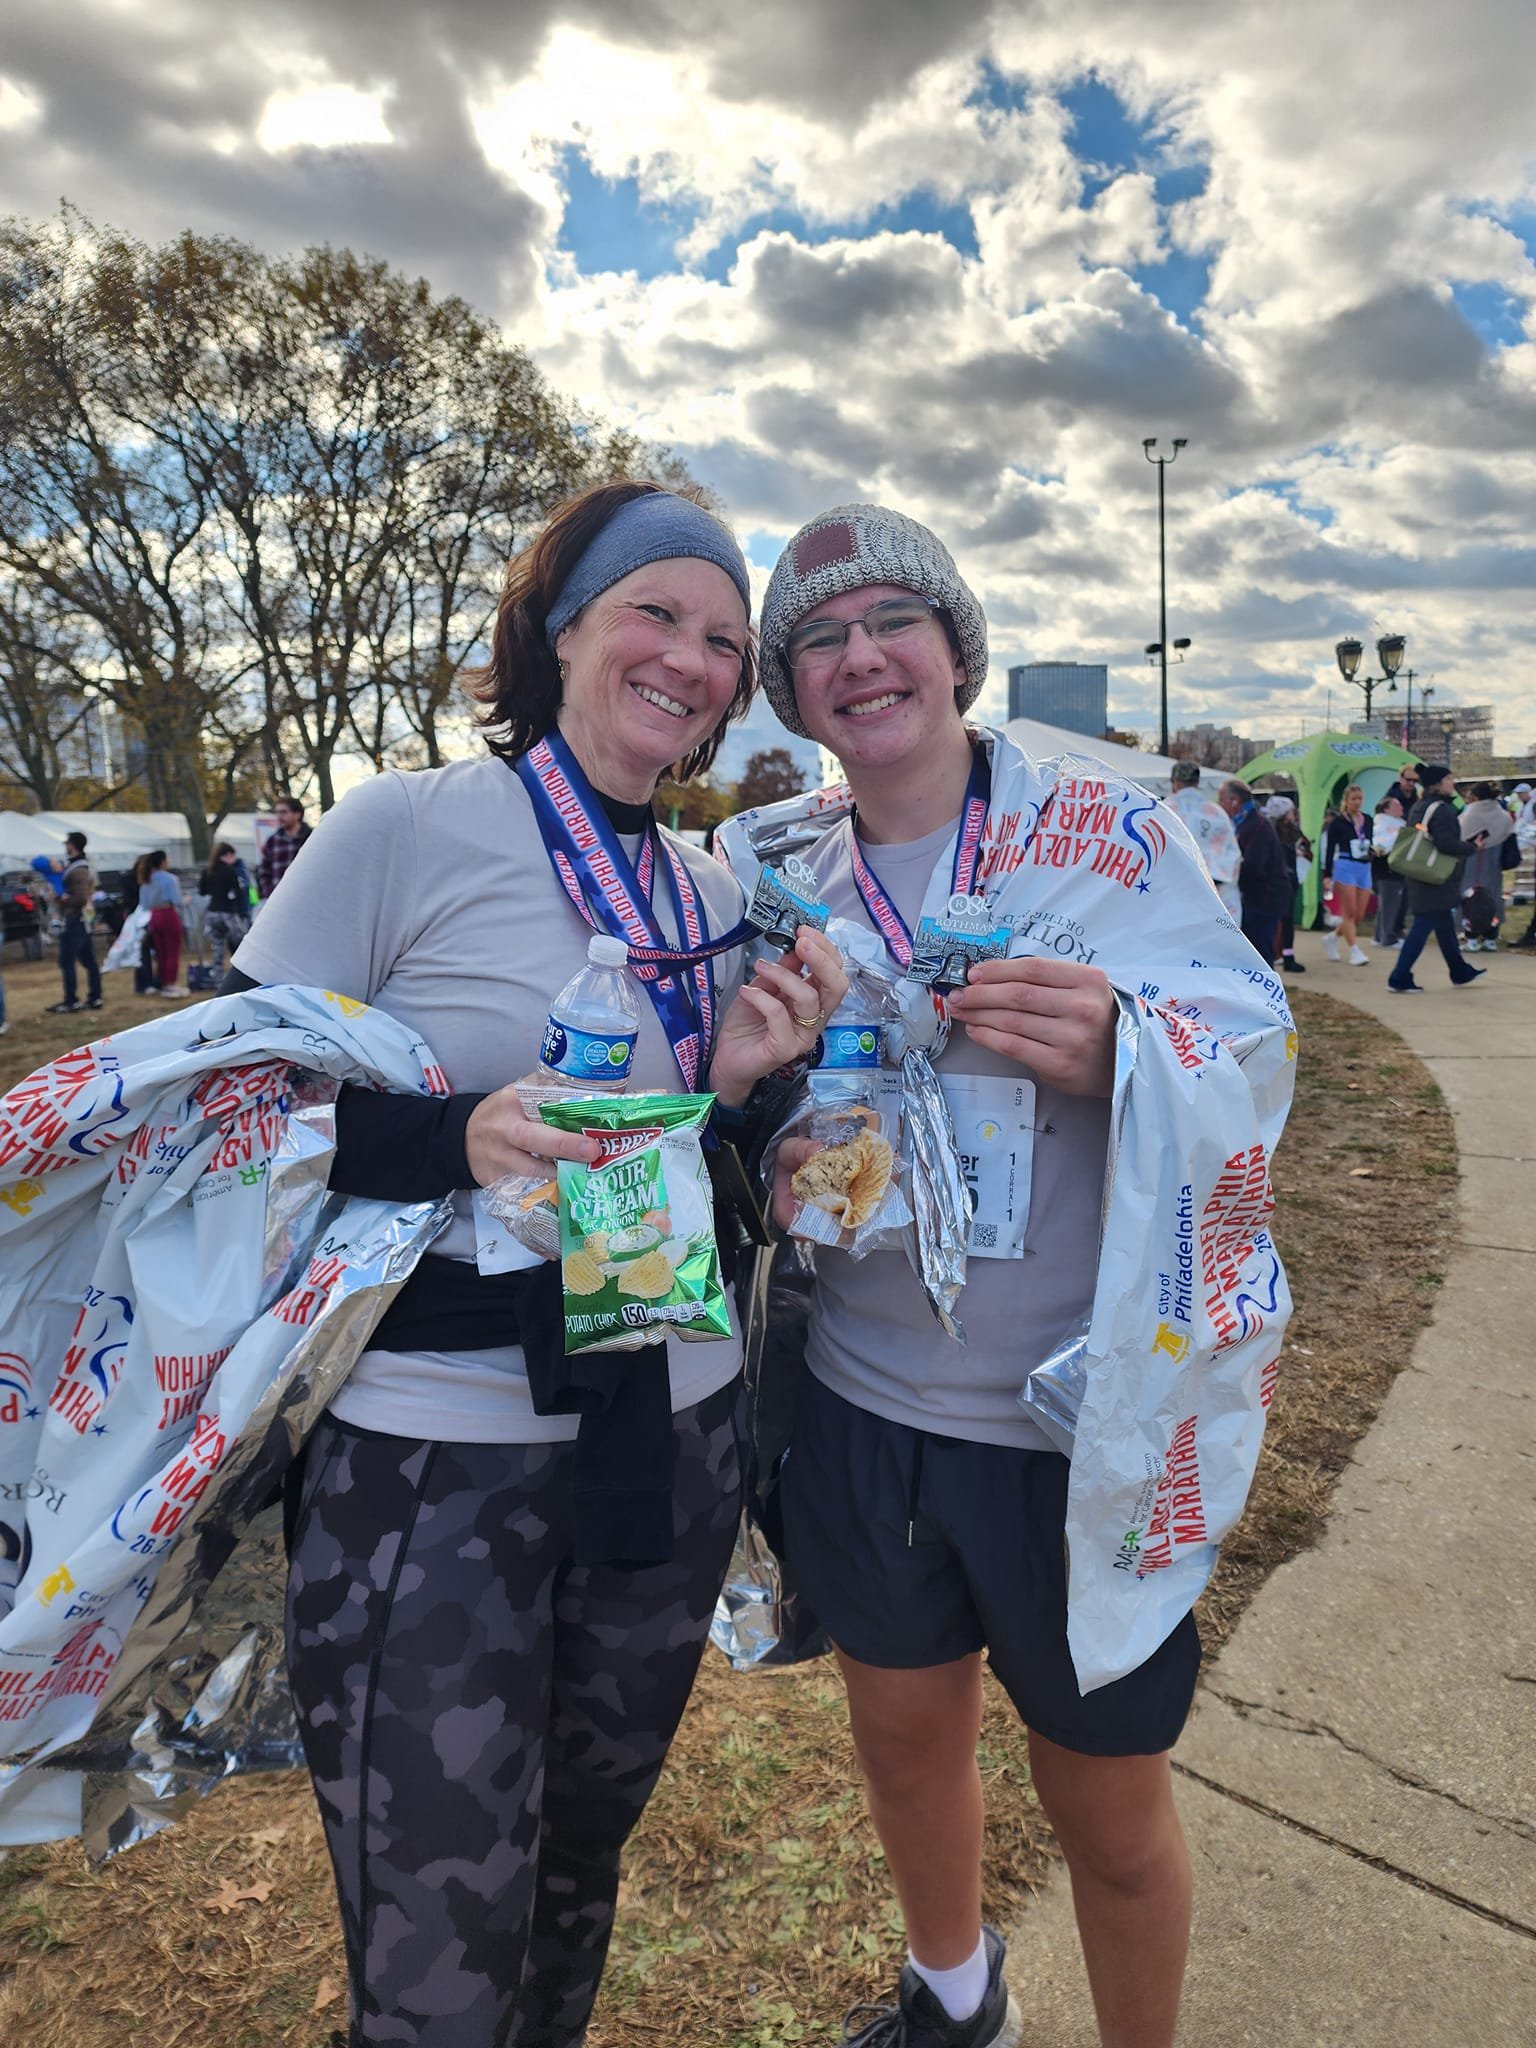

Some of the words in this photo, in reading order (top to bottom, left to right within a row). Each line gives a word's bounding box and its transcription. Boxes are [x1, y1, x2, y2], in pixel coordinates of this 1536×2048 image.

[540, 766, 600, 850] MARATHON
[962, 799, 985, 844] WEEKEND
[586, 848, 650, 947] HILADELPHIA
[934, 918, 998, 933] ROTHMAN
[1138, 982, 1160, 1001] 8K
[584, 1159, 648, 1199] SOUR
[570, 1180, 661, 1223] CREAM
[1215, 1144, 1266, 1294] MARATHON
[1175, 1184, 1192, 1323] Philadelphia
[1200, 1151, 1247, 1352] PHILADELPHIA
[1159, 1272, 1171, 1286] of
[623, 1304, 648, 1325] 150
[1158, 1286, 1171, 1316] City
[565, 1314, 594, 1333] POTATO
[1172, 1414, 1208, 1545] MARATHON
[129, 1533, 172, 1555] 26.2
